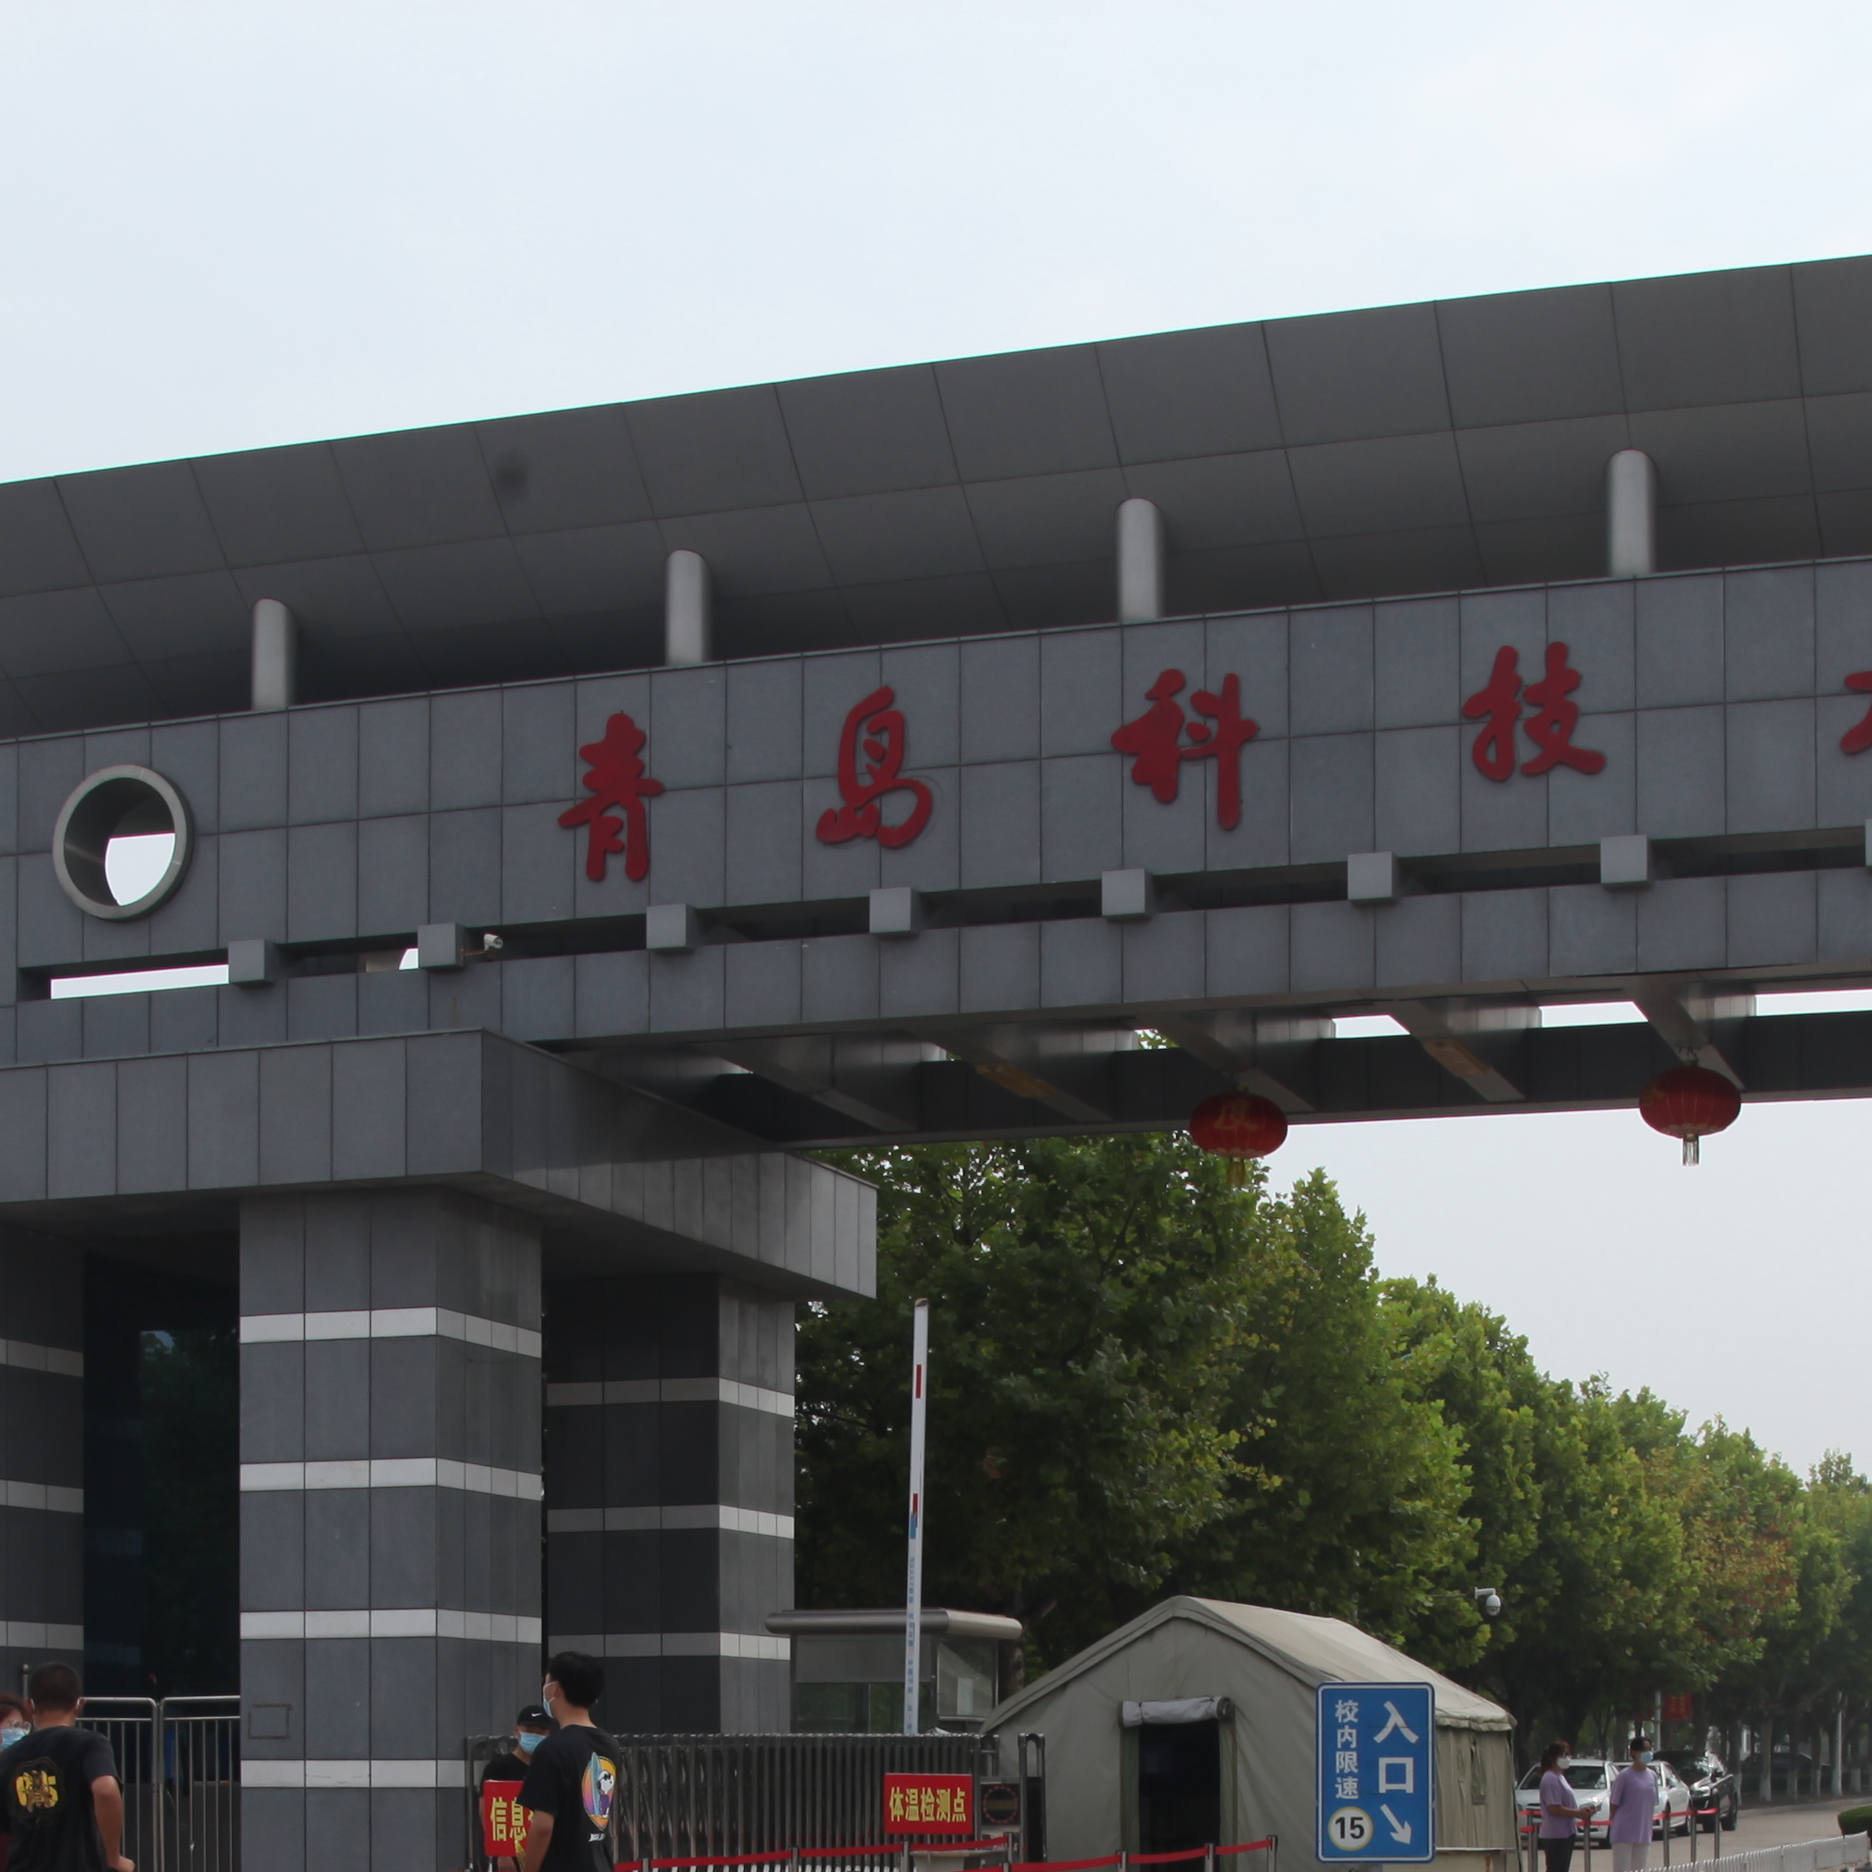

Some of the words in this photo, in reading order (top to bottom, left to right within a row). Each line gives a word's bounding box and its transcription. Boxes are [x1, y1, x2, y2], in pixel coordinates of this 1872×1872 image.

[1334, 1699, 1360, 1800] 校内限速
[1373, 1700, 1420, 1794] 入口
[490, 1796, 534, 1842] 信息
[889, 1786, 967, 1823] 体温检测点
[1334, 1817, 1365, 1840] 15
